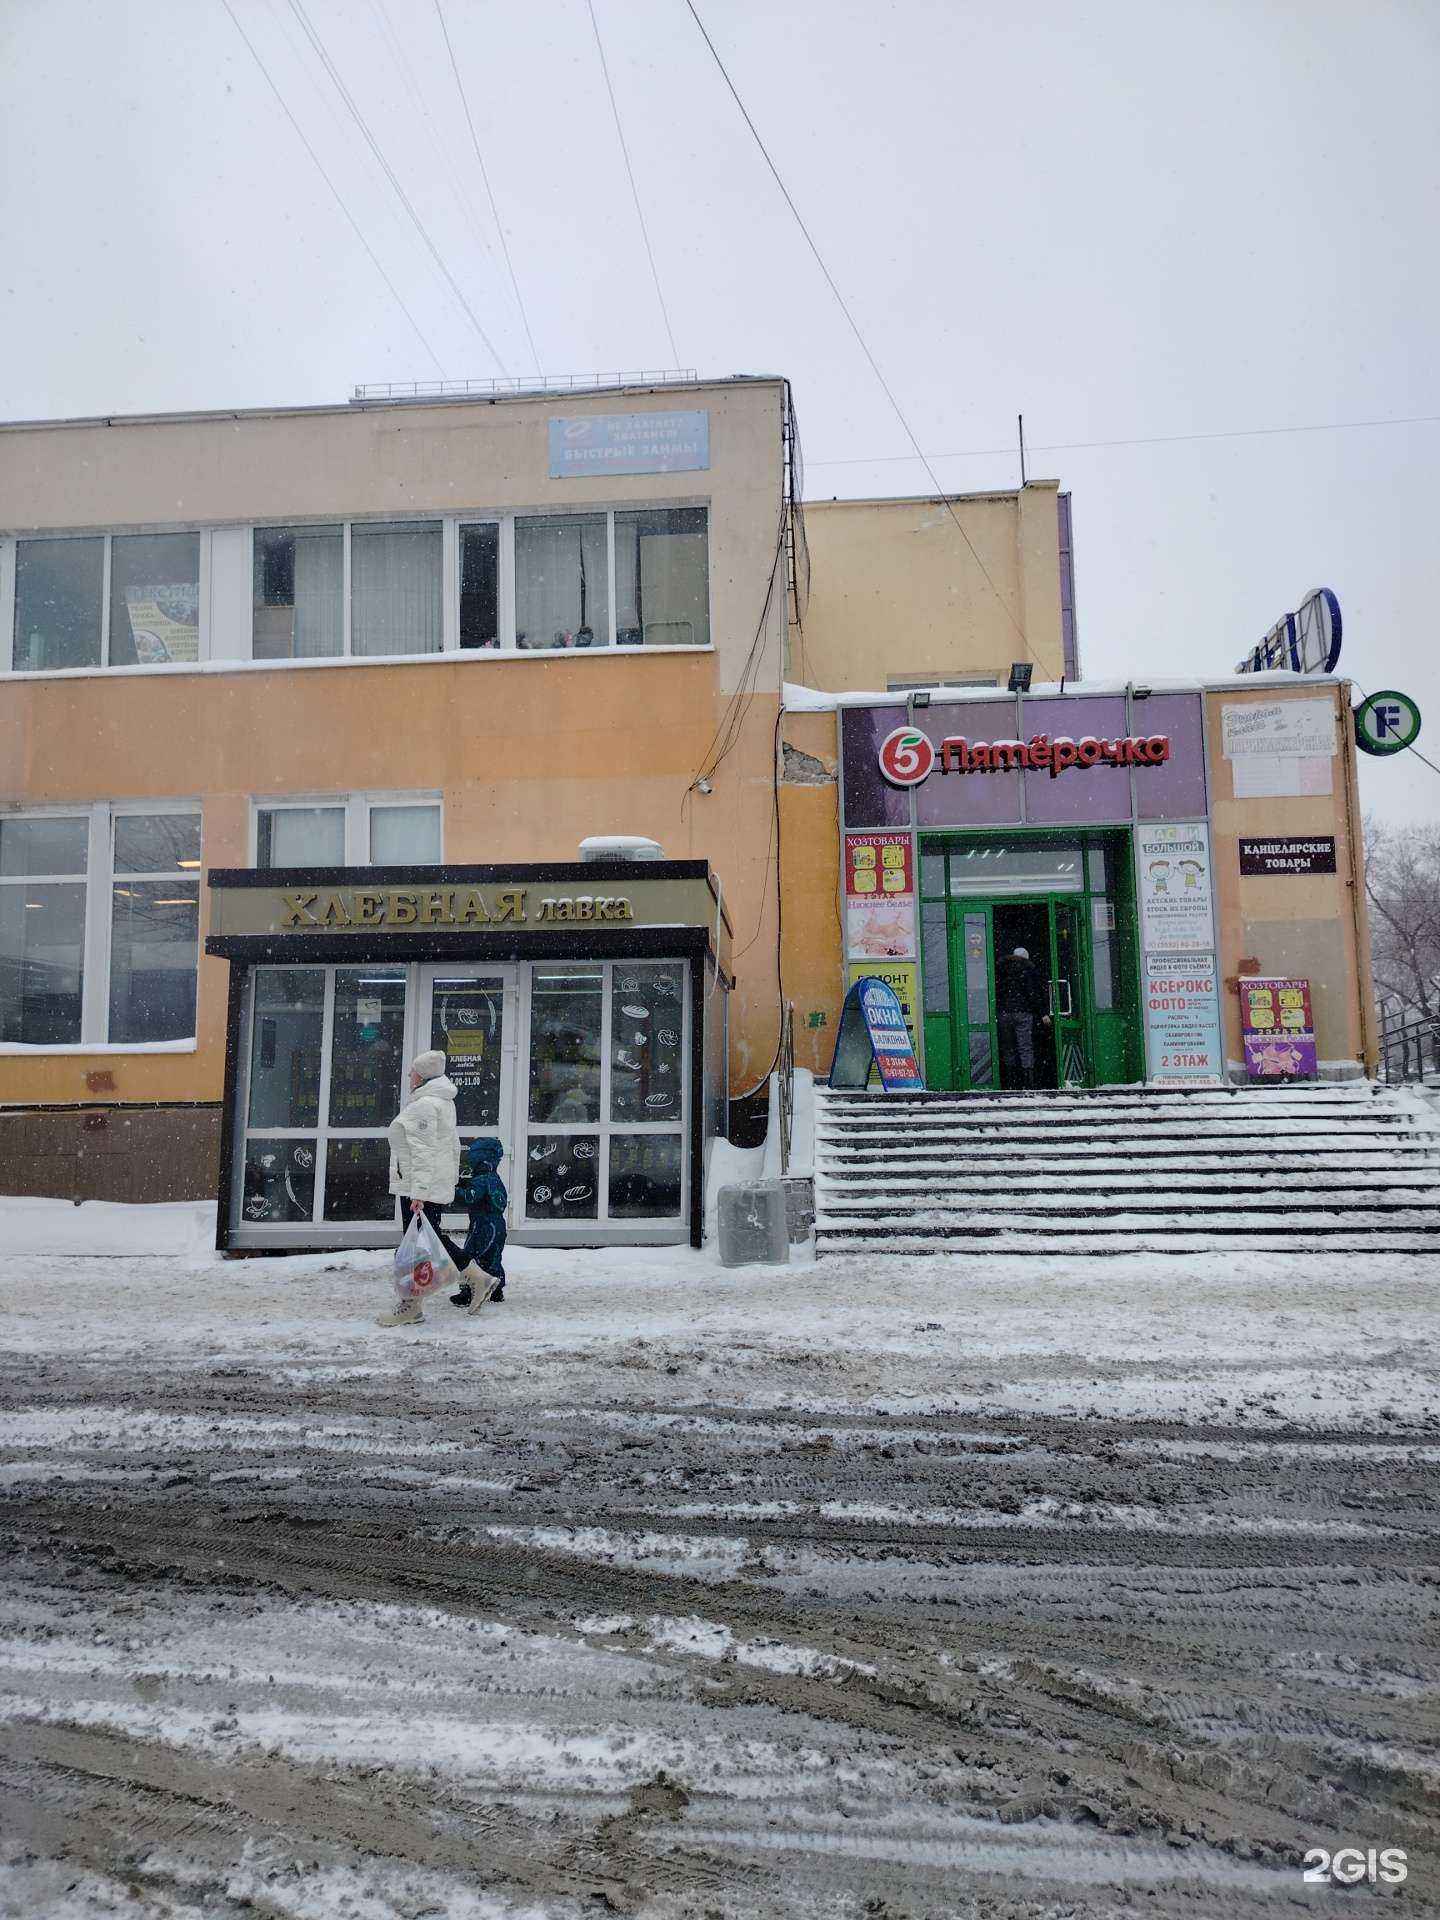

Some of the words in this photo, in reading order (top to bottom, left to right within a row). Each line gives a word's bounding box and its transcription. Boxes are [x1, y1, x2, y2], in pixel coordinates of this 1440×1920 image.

[942, 735, 1169, 779] Пятёрочка
[848, 836, 911, 846] ХОЗТОВАРЫ
[1145, 841, 1200, 853] БОЛЬШОЙ
[1243, 843, 1332, 855] КАНЦЕЛЯРСКИЕ
[1265, 858, 1311, 868] ТОВАРЫ
[281, 888, 528, 926] ХЛЕБНАЯ
[535, 896, 634, 922] лавка
[1150, 979, 1213, 993] КСЕРОКС
[1241, 981, 1308, 991] ХОЗТОВАРЫ
[1149, 998, 1186, 1010] ФОТО
[867, 1007, 901, 1026] ОКНА
[450, 1055, 482, 1063] ХЛЕБНАЯ
[892, 1058, 907, 1067] ЭТАЖ
[1161, 1055, 1169, 1067] 2
[1173, 1054, 1209, 1067] ЭТАЖ
